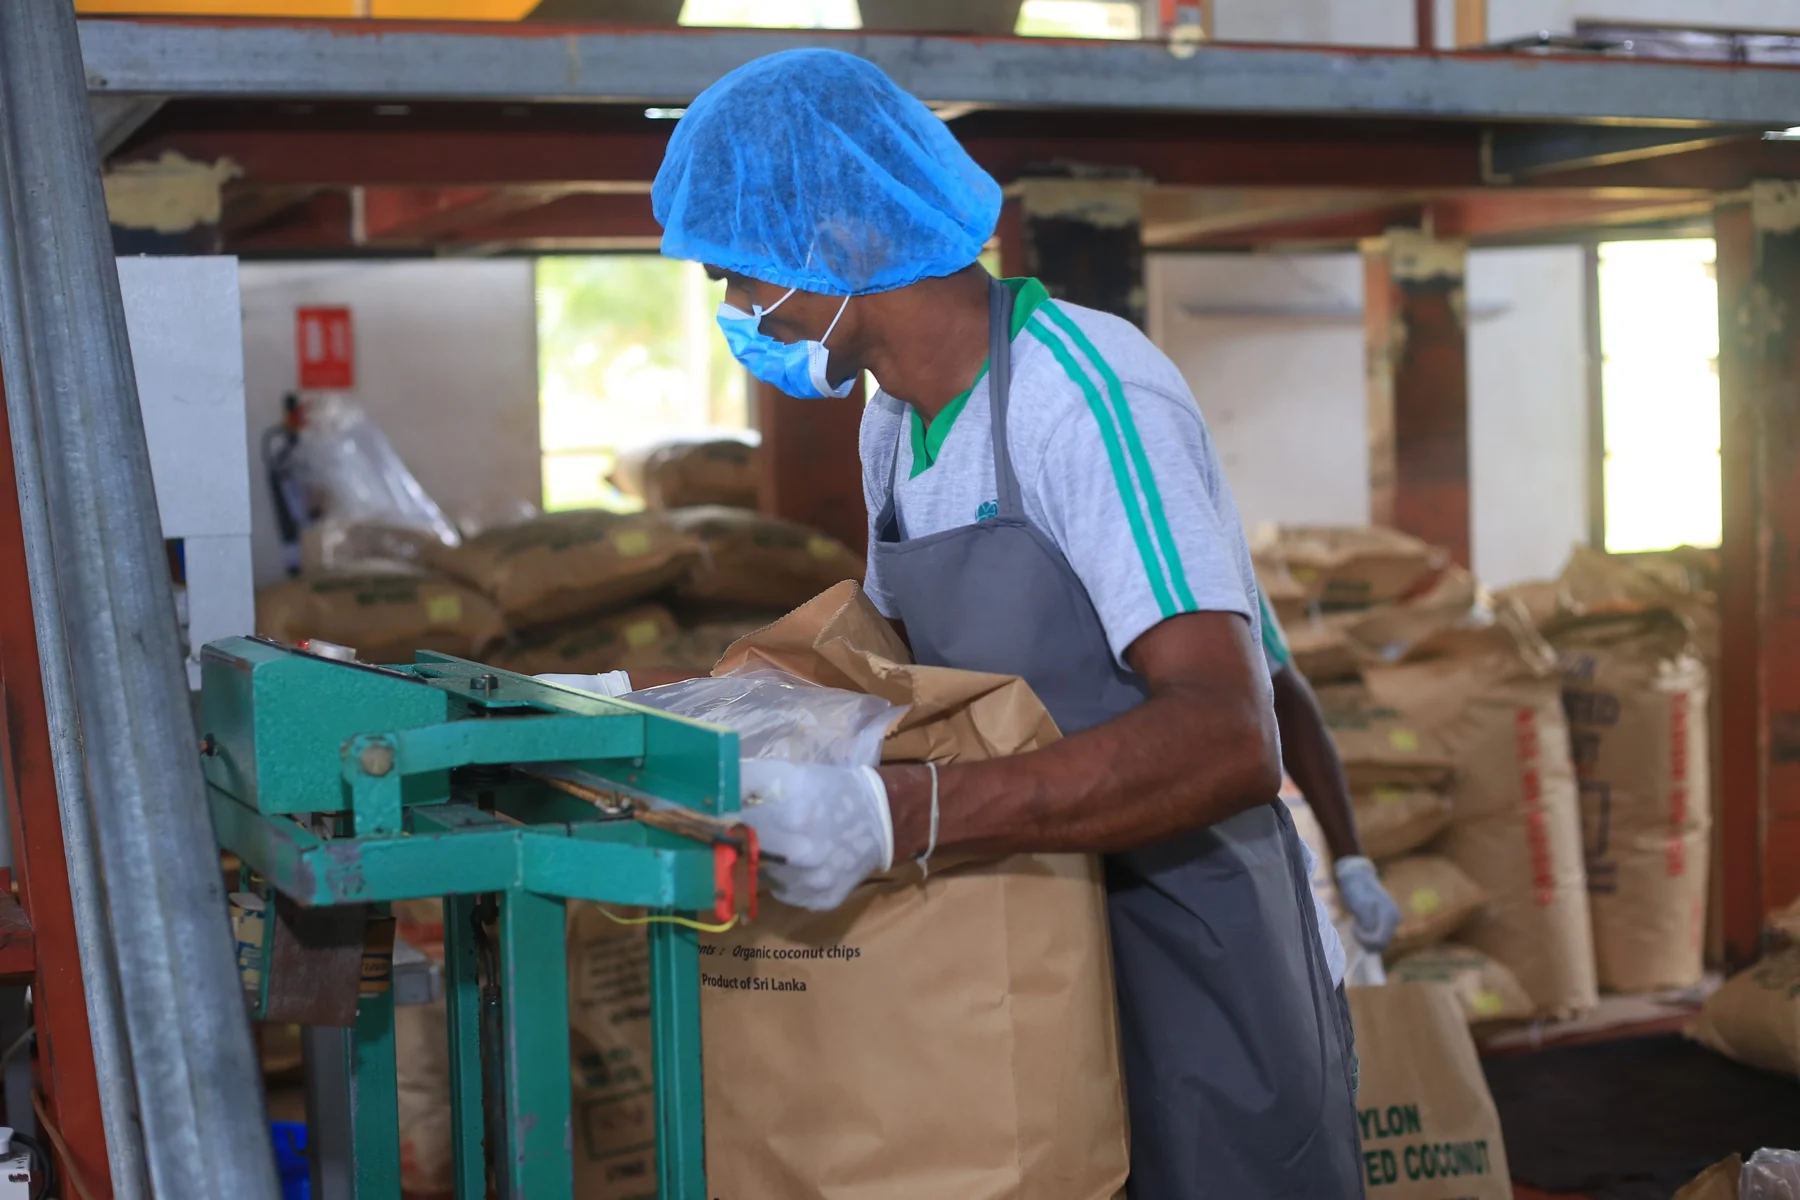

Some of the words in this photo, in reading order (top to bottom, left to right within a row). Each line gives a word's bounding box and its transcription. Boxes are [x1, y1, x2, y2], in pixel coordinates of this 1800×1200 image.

[698, 945, 716, 955] nts
[732, 944, 772, 961] Organic
[773, 946, 824, 959] coconut
[827, 944, 860, 961] chips
[702, 973, 739, 989] Product
[740, 977, 751, 990] of
[753, 978, 768, 991] Sri
[771, 978, 807, 992] Lanka
[1358, 1103, 1422, 1140] YLON
[1362, 1148, 1398, 1186] ED
